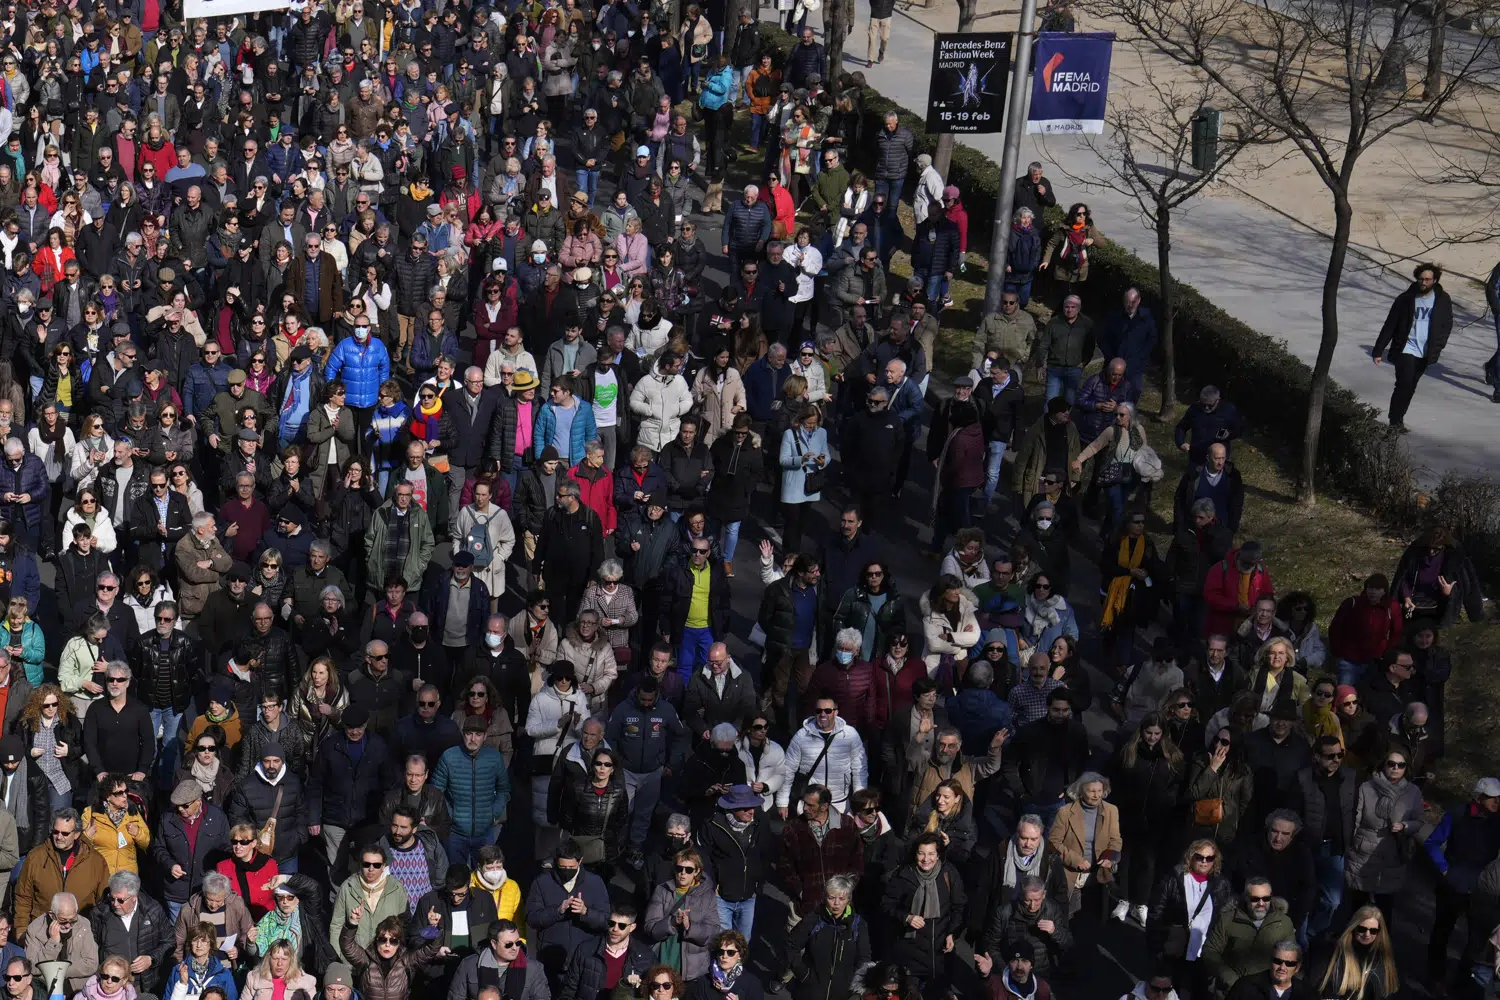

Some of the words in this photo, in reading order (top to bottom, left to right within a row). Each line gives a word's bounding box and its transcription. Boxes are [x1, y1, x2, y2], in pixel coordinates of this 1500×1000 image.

[940, 40, 1006, 50] Mercedes-Benz
[938, 61, 965, 69] MADRID
[1053, 72, 1091, 82] IFEMA
[1052, 82, 1100, 93] MADRID
[971, 111, 991, 121] feb
